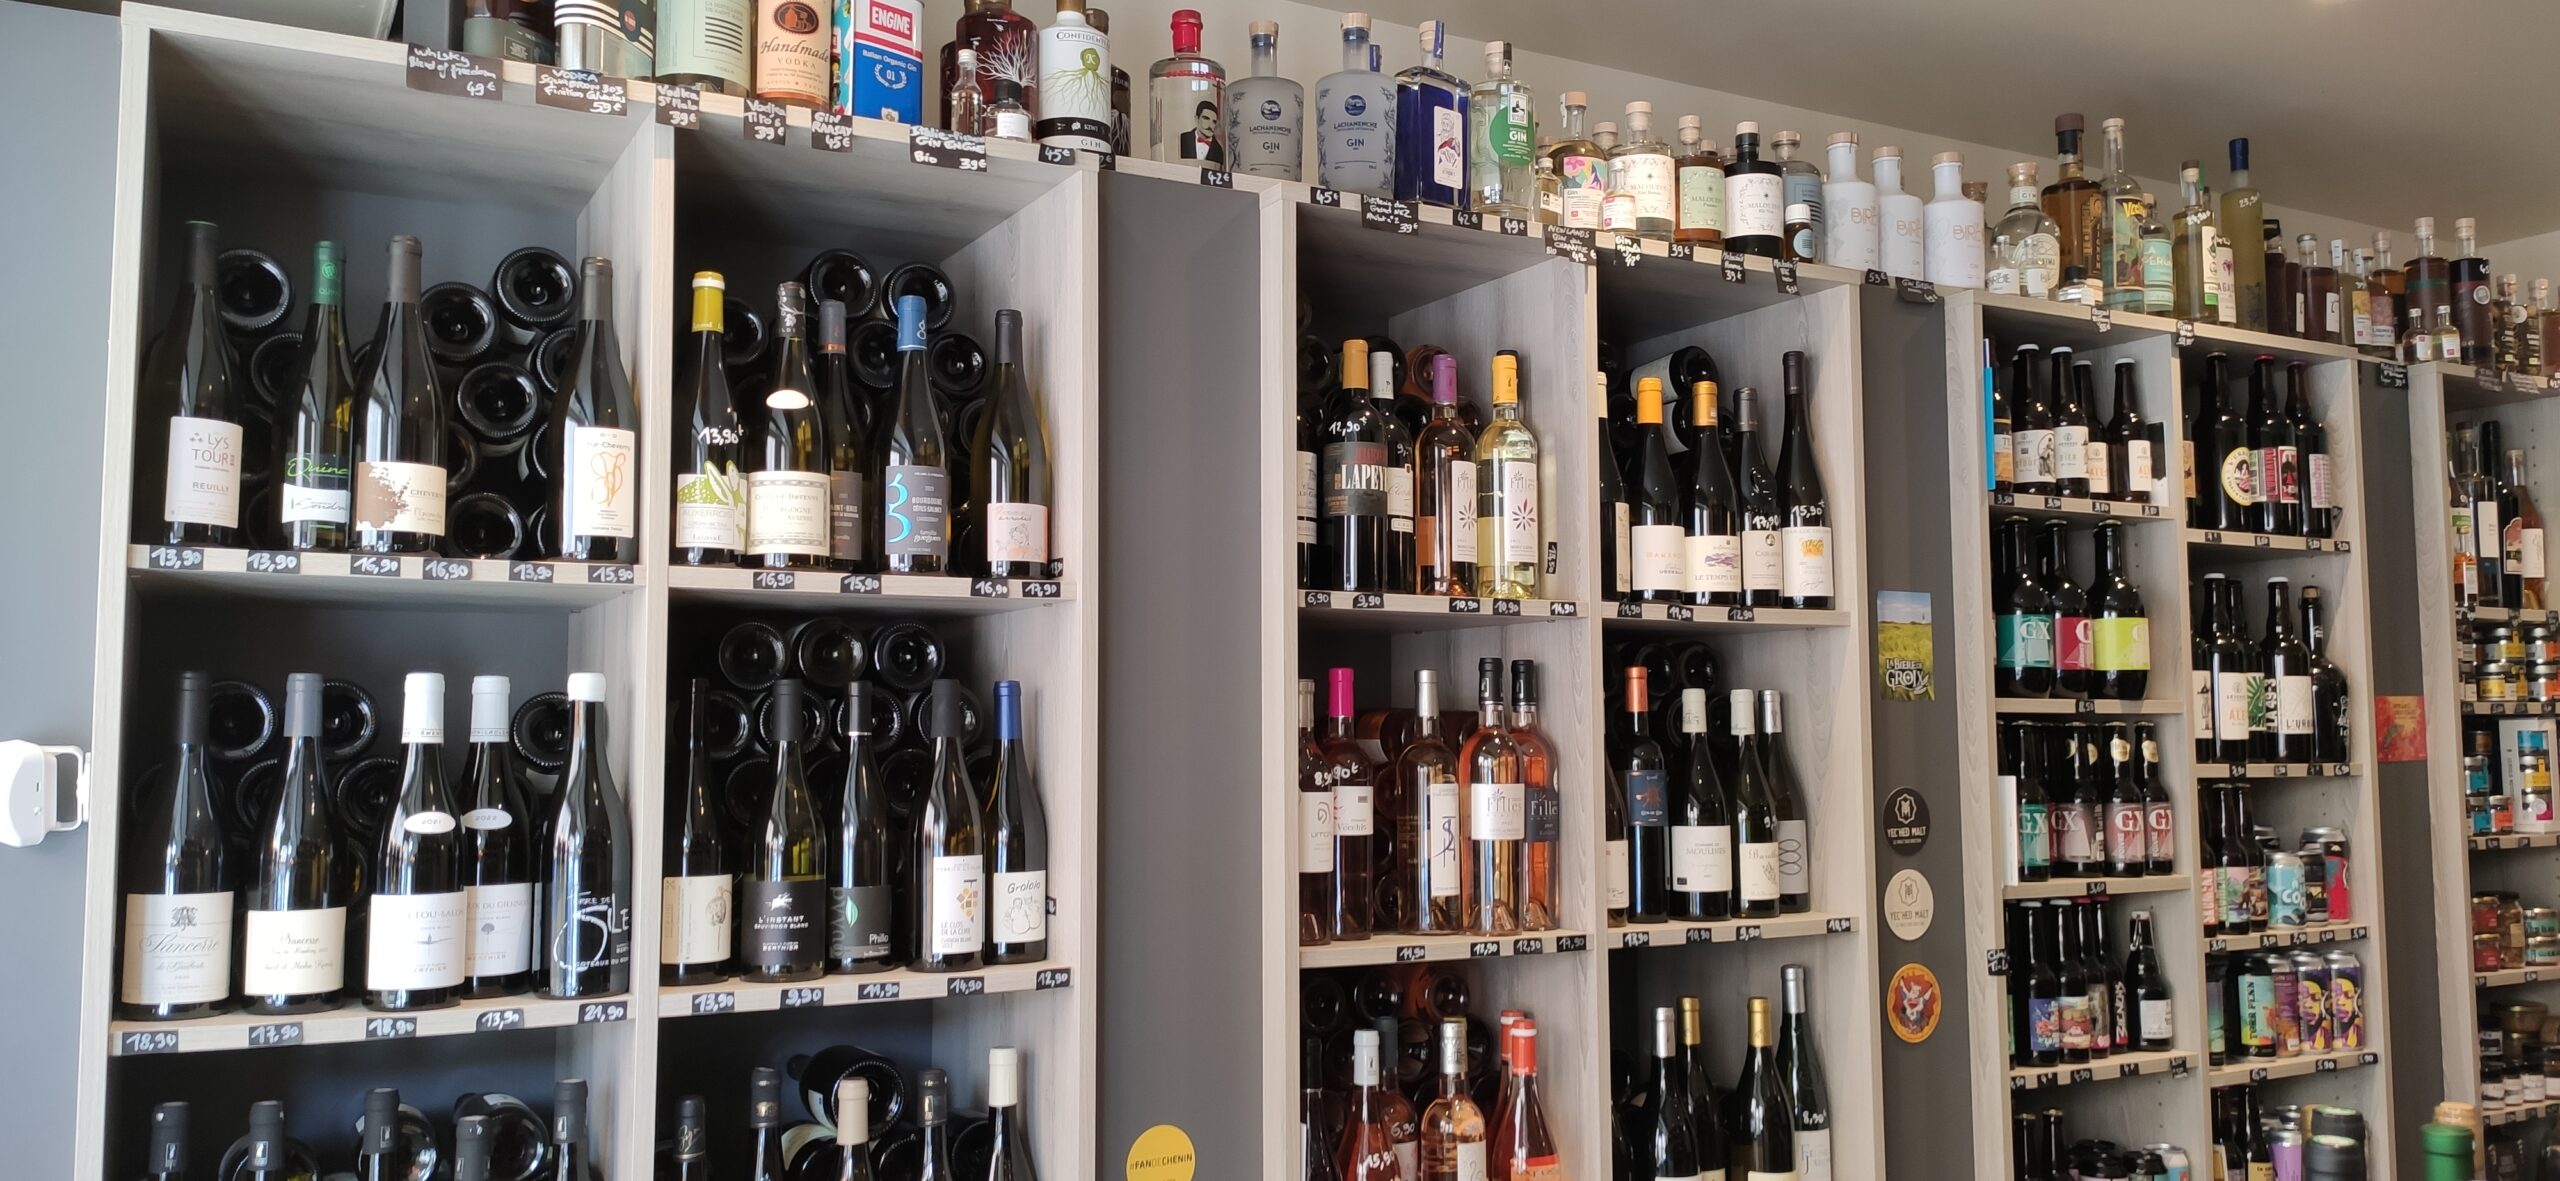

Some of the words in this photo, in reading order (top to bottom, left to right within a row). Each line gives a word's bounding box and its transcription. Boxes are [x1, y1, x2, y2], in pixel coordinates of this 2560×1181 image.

[871, 7, 911, 36] ENGINE
[760, 37, 830, 63] Handmade
[777, 57, 817, 70] VODKA
[862, 49, 883, 62] Italian
[883, 53, 906, 68] Organic
[906, 61, 918, 73] Gin
[1346, 137, 1365, 148] GIN
[1509, 130, 1527, 143] GIN
[1262, 141, 1281, 151] GIN
[913, 150, 938, 164] Bio
[207, 433, 230, 450] LYS
[191, 448, 229, 466] TOUR
[192, 481, 230, 493] REUILLY
[151, 547, 202, 569] 13,90
[247, 551, 298, 573] 13,90
[353, 559, 399, 575] 16,90
[425, 561, 469, 580] 16,90
[513, 563, 553, 581] 13,90
[592, 566, 634, 583] 15,90
[757, 572, 794, 587] 16,90
[843, 576, 880, 593] 15,90
[974, 580, 1008, 597] 16,90
[1025, 583, 1058, 597] 17,90
[1307, 593, 1330, 605] 6,90
[1355, 595, 1381, 608] 9,90
[1451, 600, 1479, 611] 10,90
[1730, 607, 1753, 620] 12,90
[2019, 621, 2051, 640] GX
[1885, 669, 1930, 692] GROIX
[2019, 812, 2047, 834] GX
[950, 978, 983, 995] 14,90
[1038, 971, 1069, 987] 12,90
[785, 989, 822, 1007] 9,90
[862, 983, 899, 998] 11,90
[694, 994, 734, 1012] 13,90
[481, 1010, 519, 1029] 13,90
[583, 1004, 623, 1023] 21,90
[250, 1024, 299, 1044] 17,90
[369, 1017, 415, 1036] 18,90
[126, 1031, 177, 1052] 18,90
